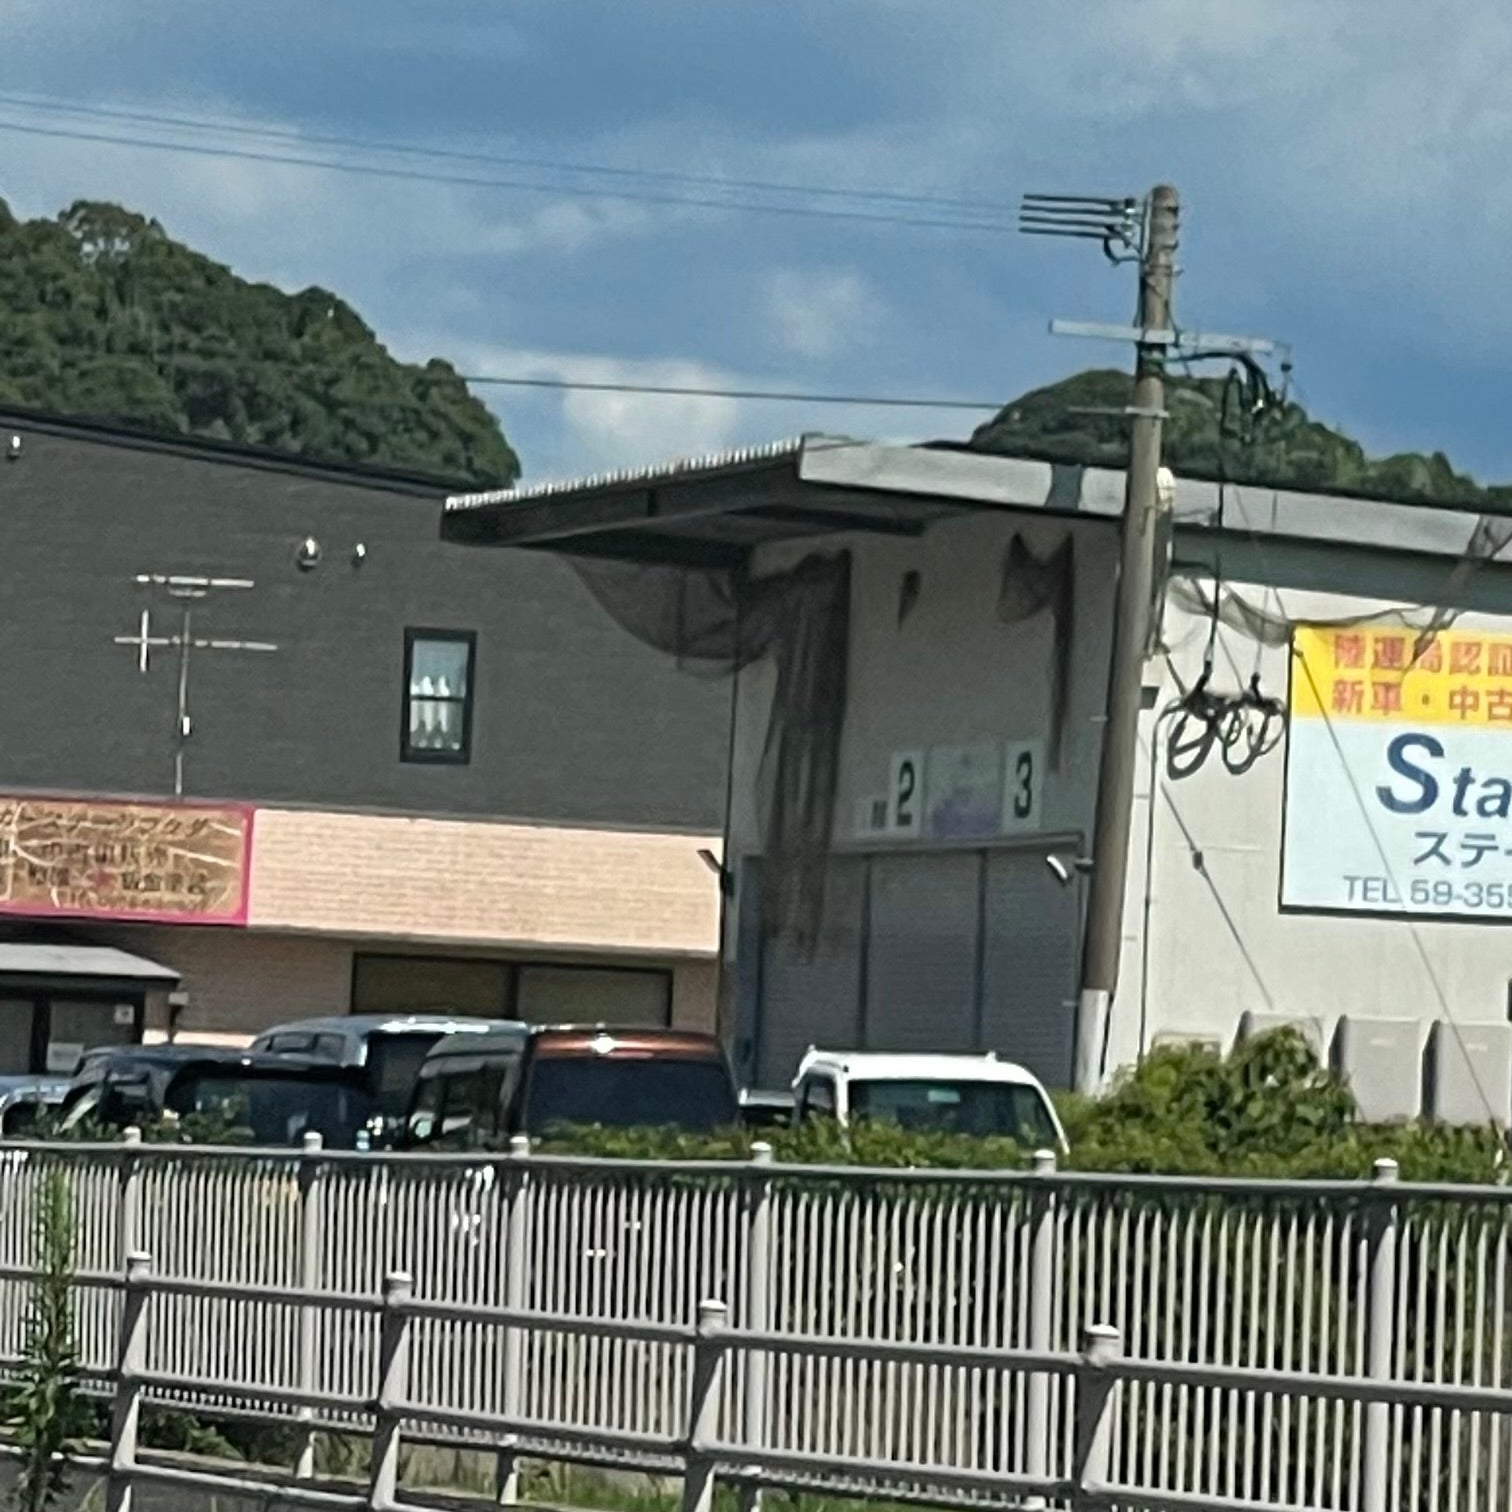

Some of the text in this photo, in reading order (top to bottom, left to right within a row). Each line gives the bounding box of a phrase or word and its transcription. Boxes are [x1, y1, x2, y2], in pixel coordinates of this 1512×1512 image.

[896, 760, 915, 826] 2
[1014, 750, 1033, 819] 3
[1343, 875, 1402, 904] TEL
